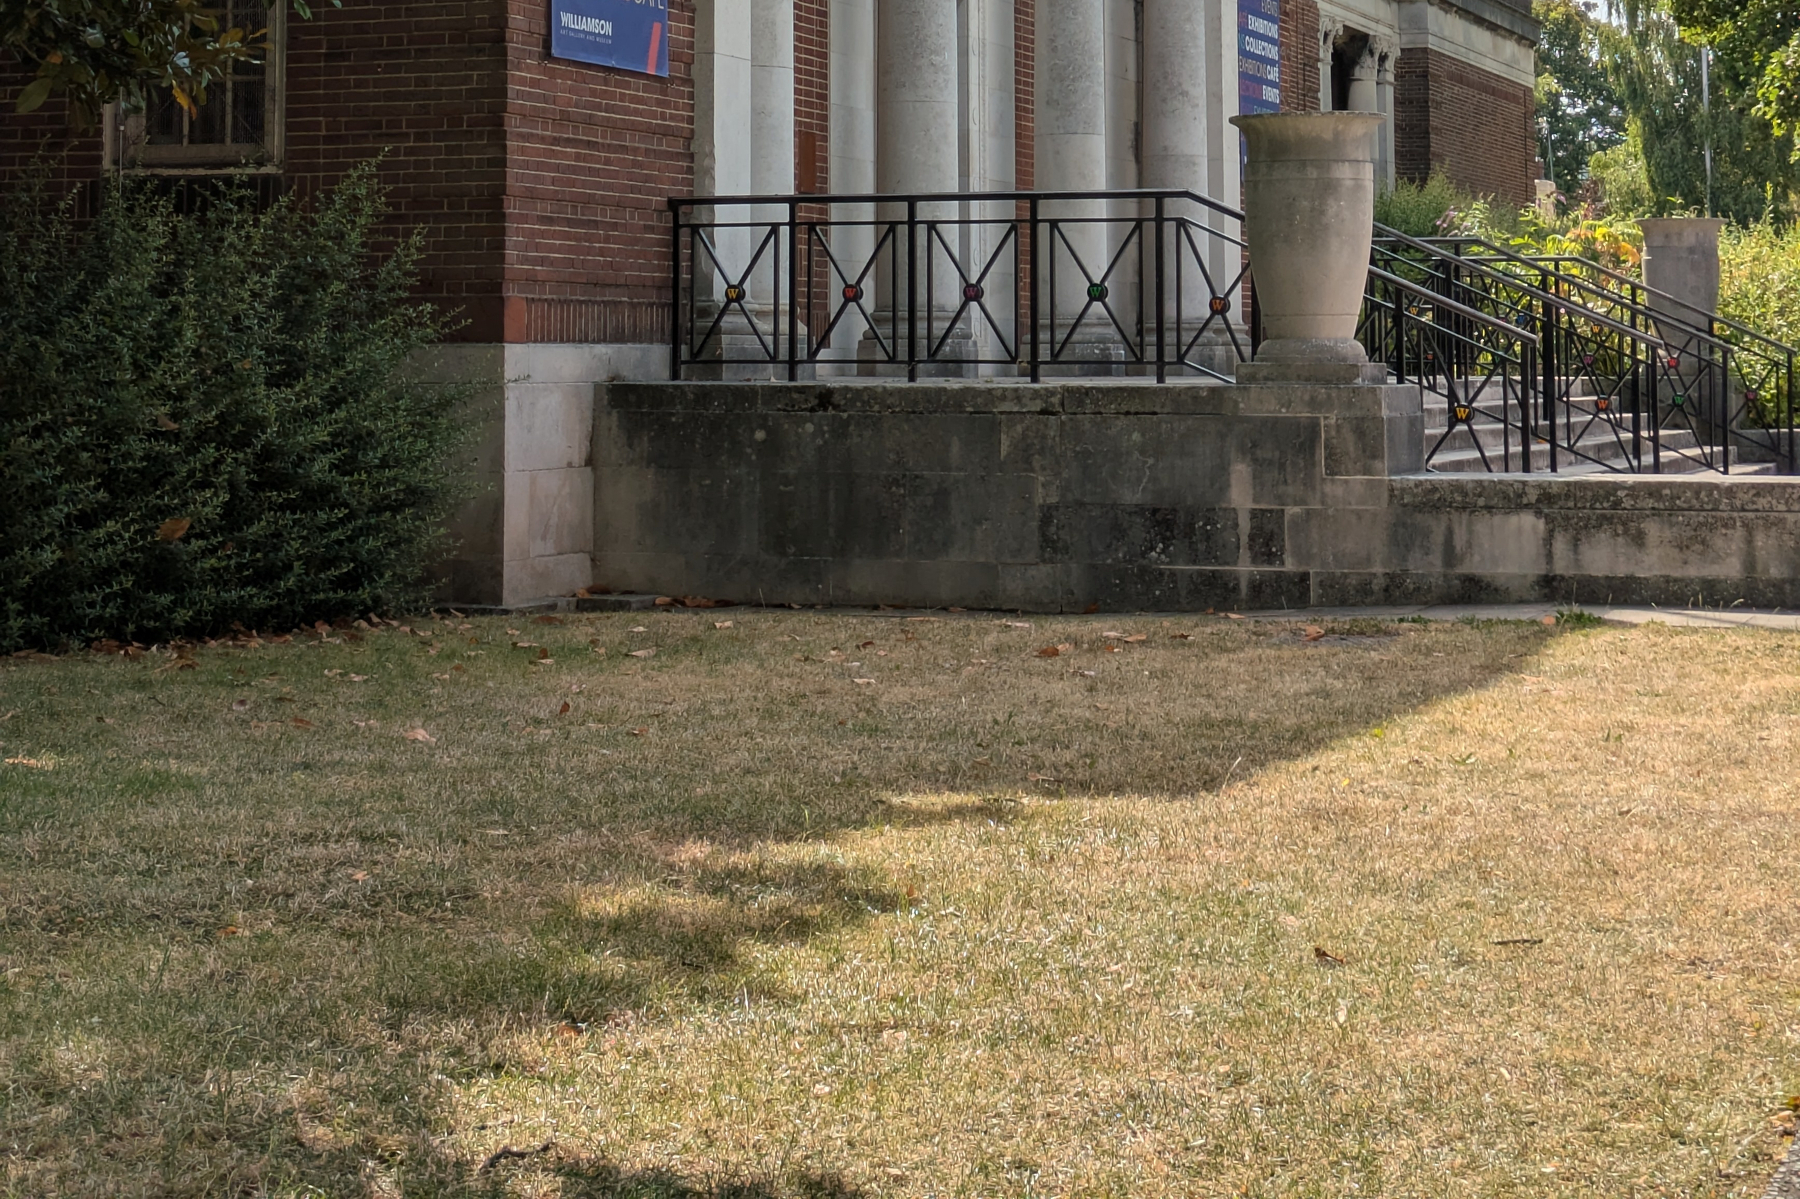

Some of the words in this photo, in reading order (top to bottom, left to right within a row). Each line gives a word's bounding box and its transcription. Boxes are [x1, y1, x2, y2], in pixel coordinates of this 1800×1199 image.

[560, 11, 612, 36] WILLIAMSON
[1248, 14, 1278, 40] EXHIBITIONS
[1245, 35, 1278, 62] COLLECTIONS
[1266, 63, 1279, 83] CAFÉ
[1262, 85, 1280, 105] EVENTS
[727, 288, 739, 300] W
[1455, 407, 1471, 420] W
